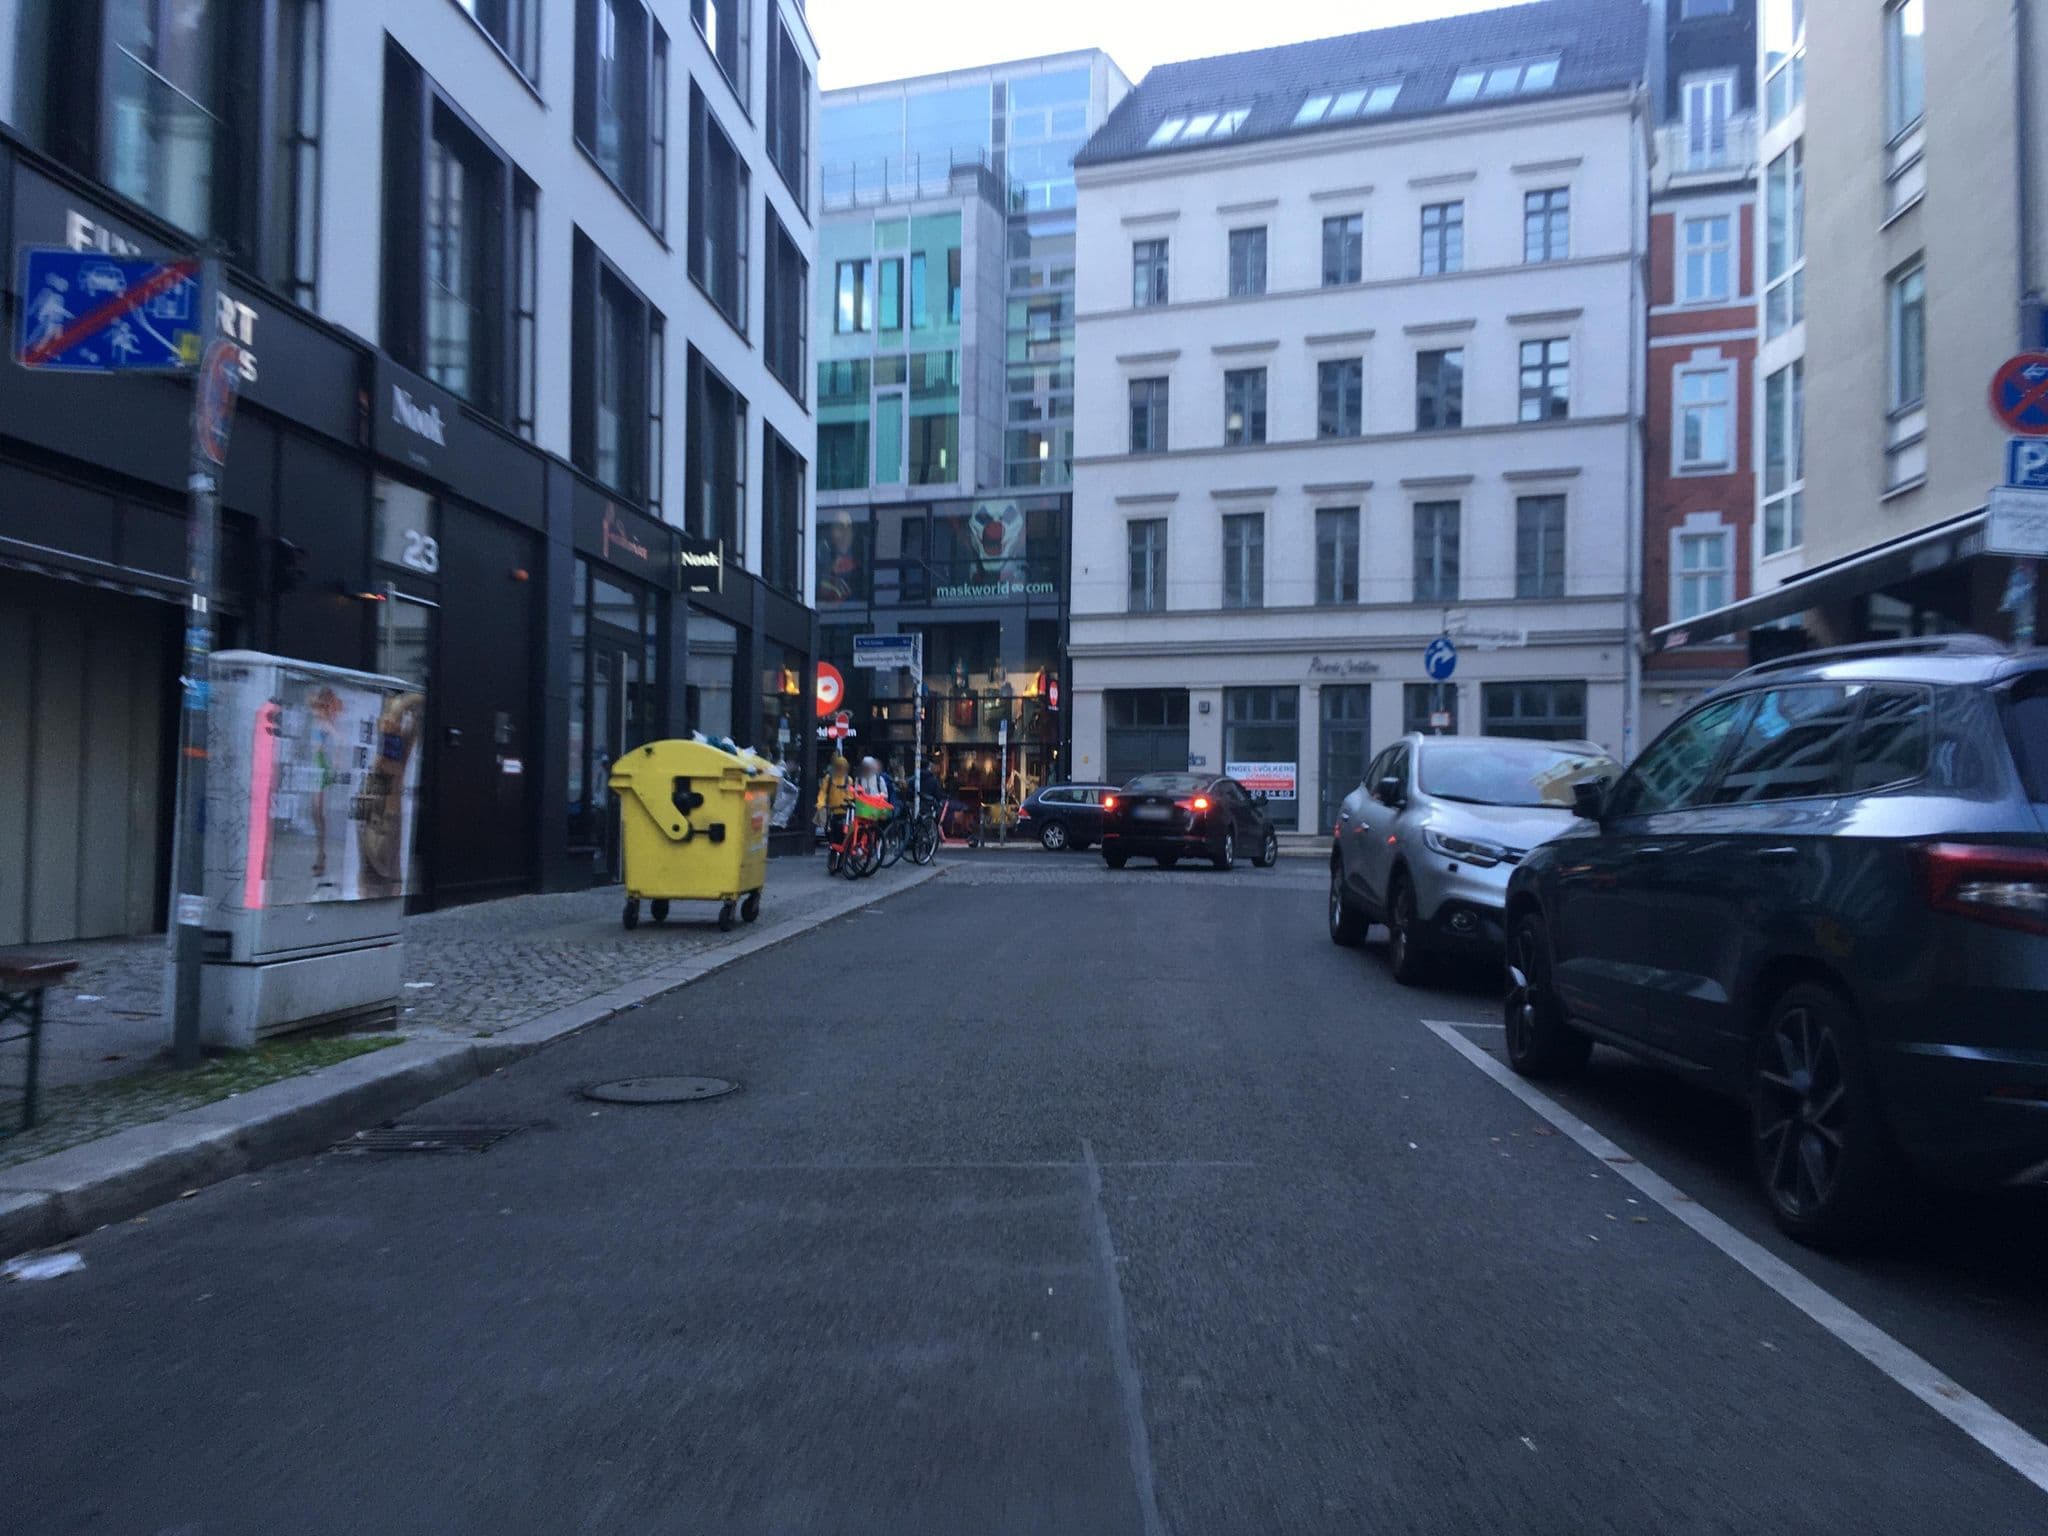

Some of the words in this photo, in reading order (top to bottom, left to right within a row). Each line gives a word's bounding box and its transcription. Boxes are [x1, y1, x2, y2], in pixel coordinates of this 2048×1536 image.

[402, 529, 440, 573] 23
[681, 551, 719, 567] Nook
[936, 581, 1009, 597] maskworld
